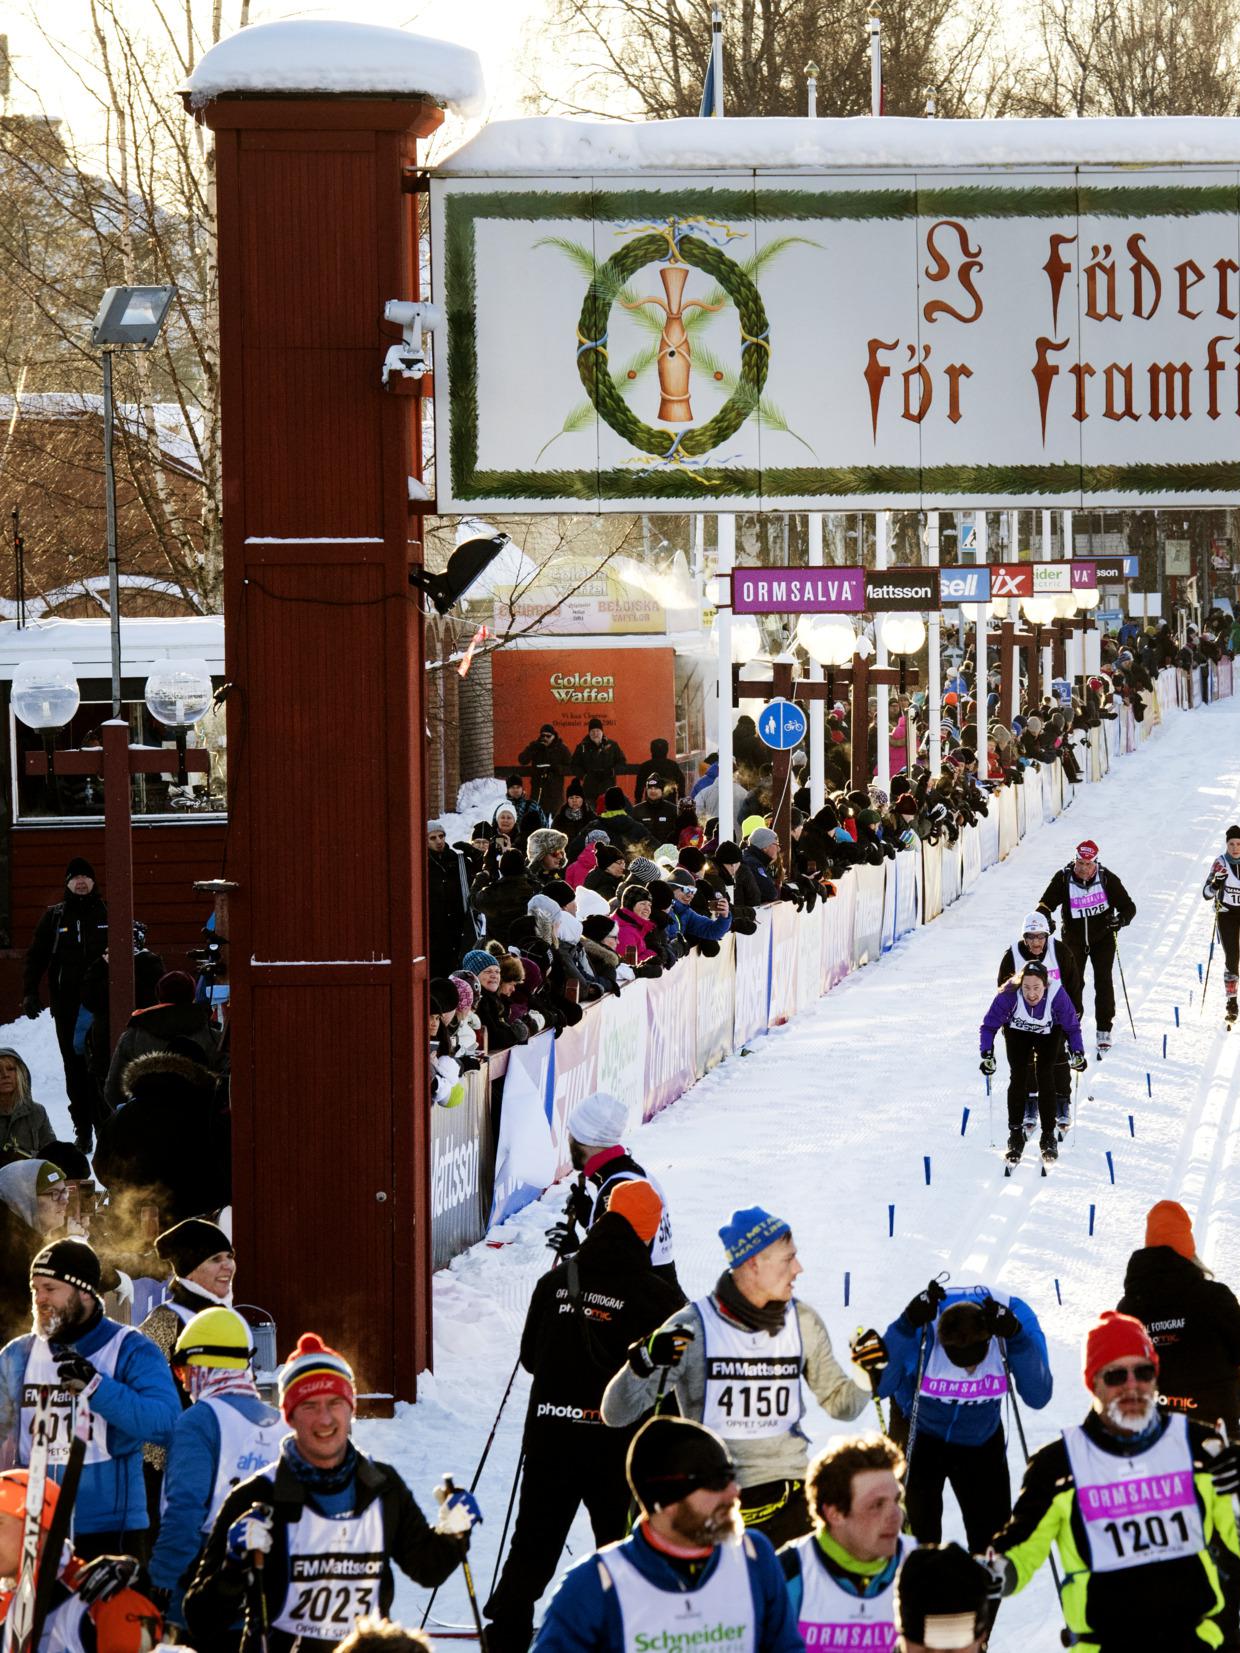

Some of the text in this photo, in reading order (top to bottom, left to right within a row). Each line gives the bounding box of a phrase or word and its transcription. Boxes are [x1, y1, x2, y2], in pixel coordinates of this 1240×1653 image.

[550, 672, 615, 688] Golden
[550, 688, 615, 704] Waffel
[588, 1293, 624, 1310] FOTOGRAF
[1151, 1318, 1185, 1333] FOTOGRAF
[712, 1362, 798, 1377] FM Mattsson
[929, 1377, 1000, 1393] ORMSALVA
[717, 1386, 790, 1417] 4150
[1088, 1475, 1184, 1508] ORMSALVA
[1104, 1510, 1189, 1558] 1201
[294, 1562, 319, 1577] FM
[289, 1587, 373, 1624] 2023
[634, 1621, 747, 1653] Schneider
